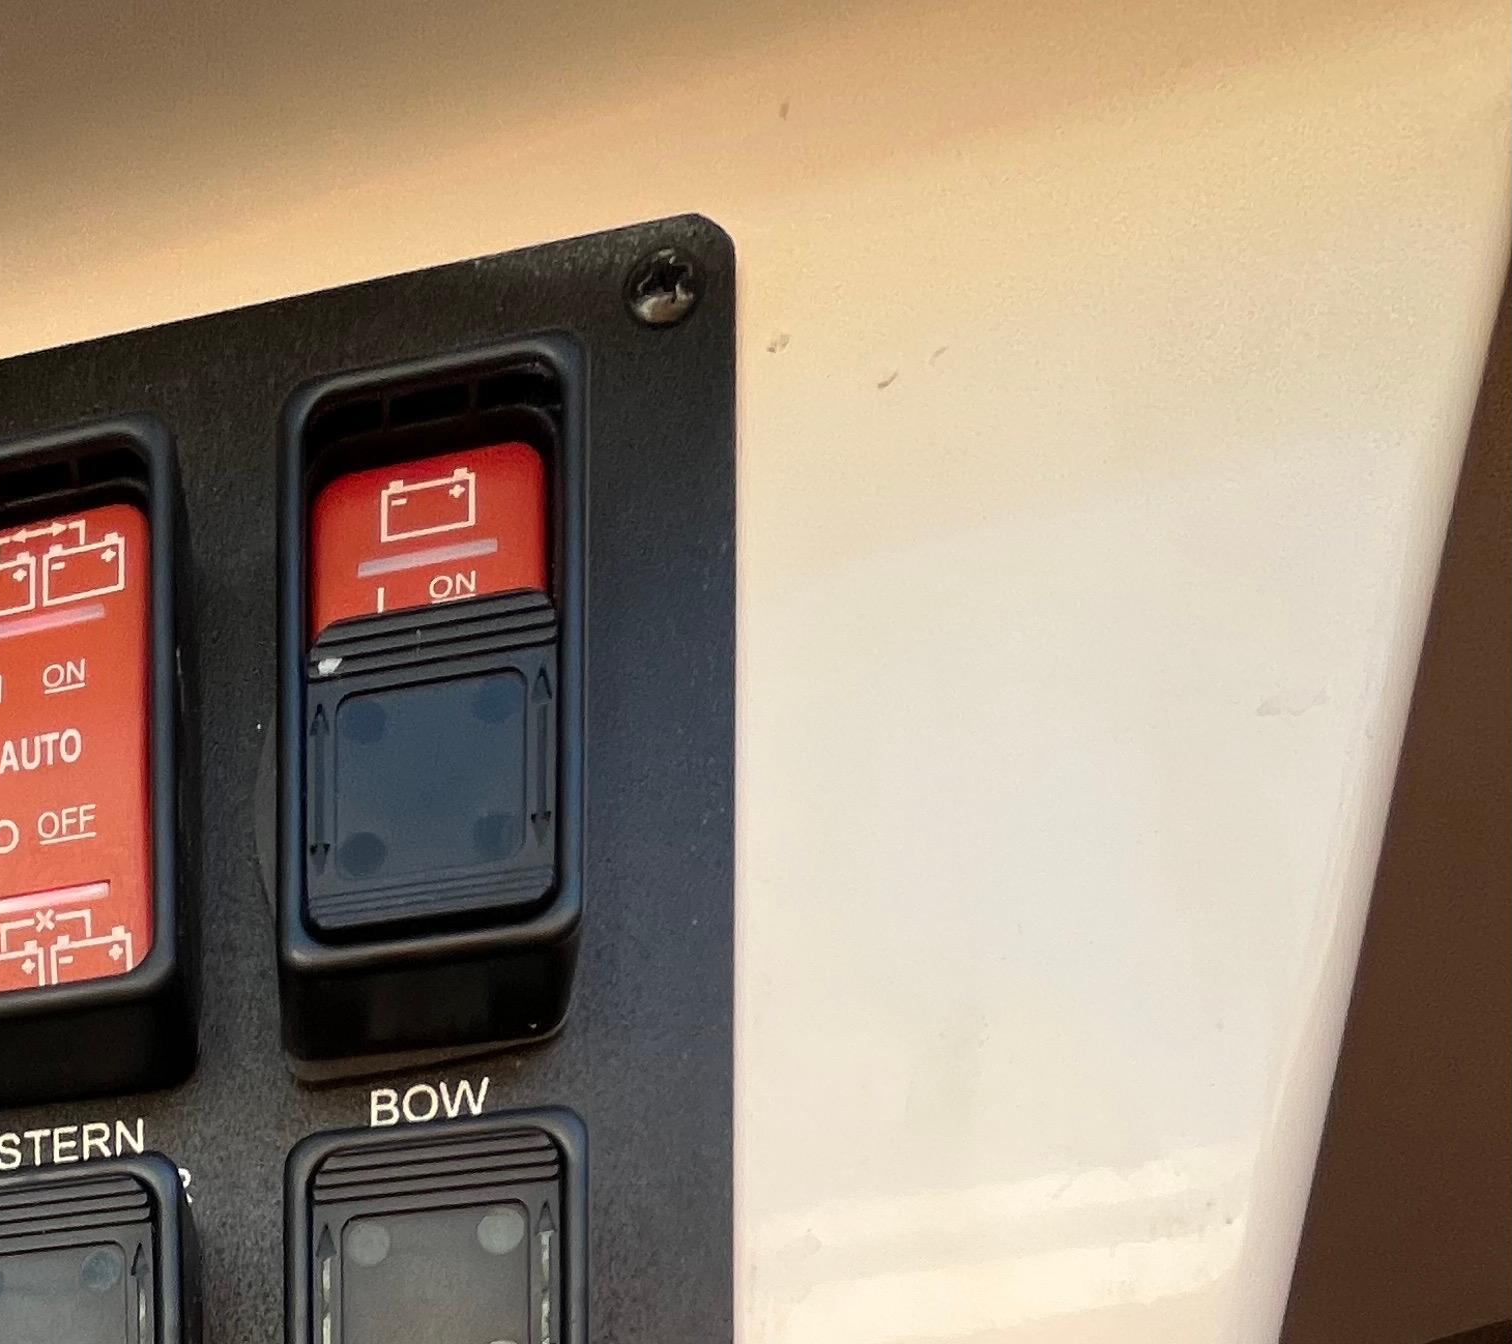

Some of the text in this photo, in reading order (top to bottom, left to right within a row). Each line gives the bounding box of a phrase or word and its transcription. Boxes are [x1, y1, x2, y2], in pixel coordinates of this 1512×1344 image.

[428, 569, 477, 601] ON
[41, 658, 87, 692] ON
[37, 803, 97, 842] OFF
[369, 1076, 491, 1128] BOW
